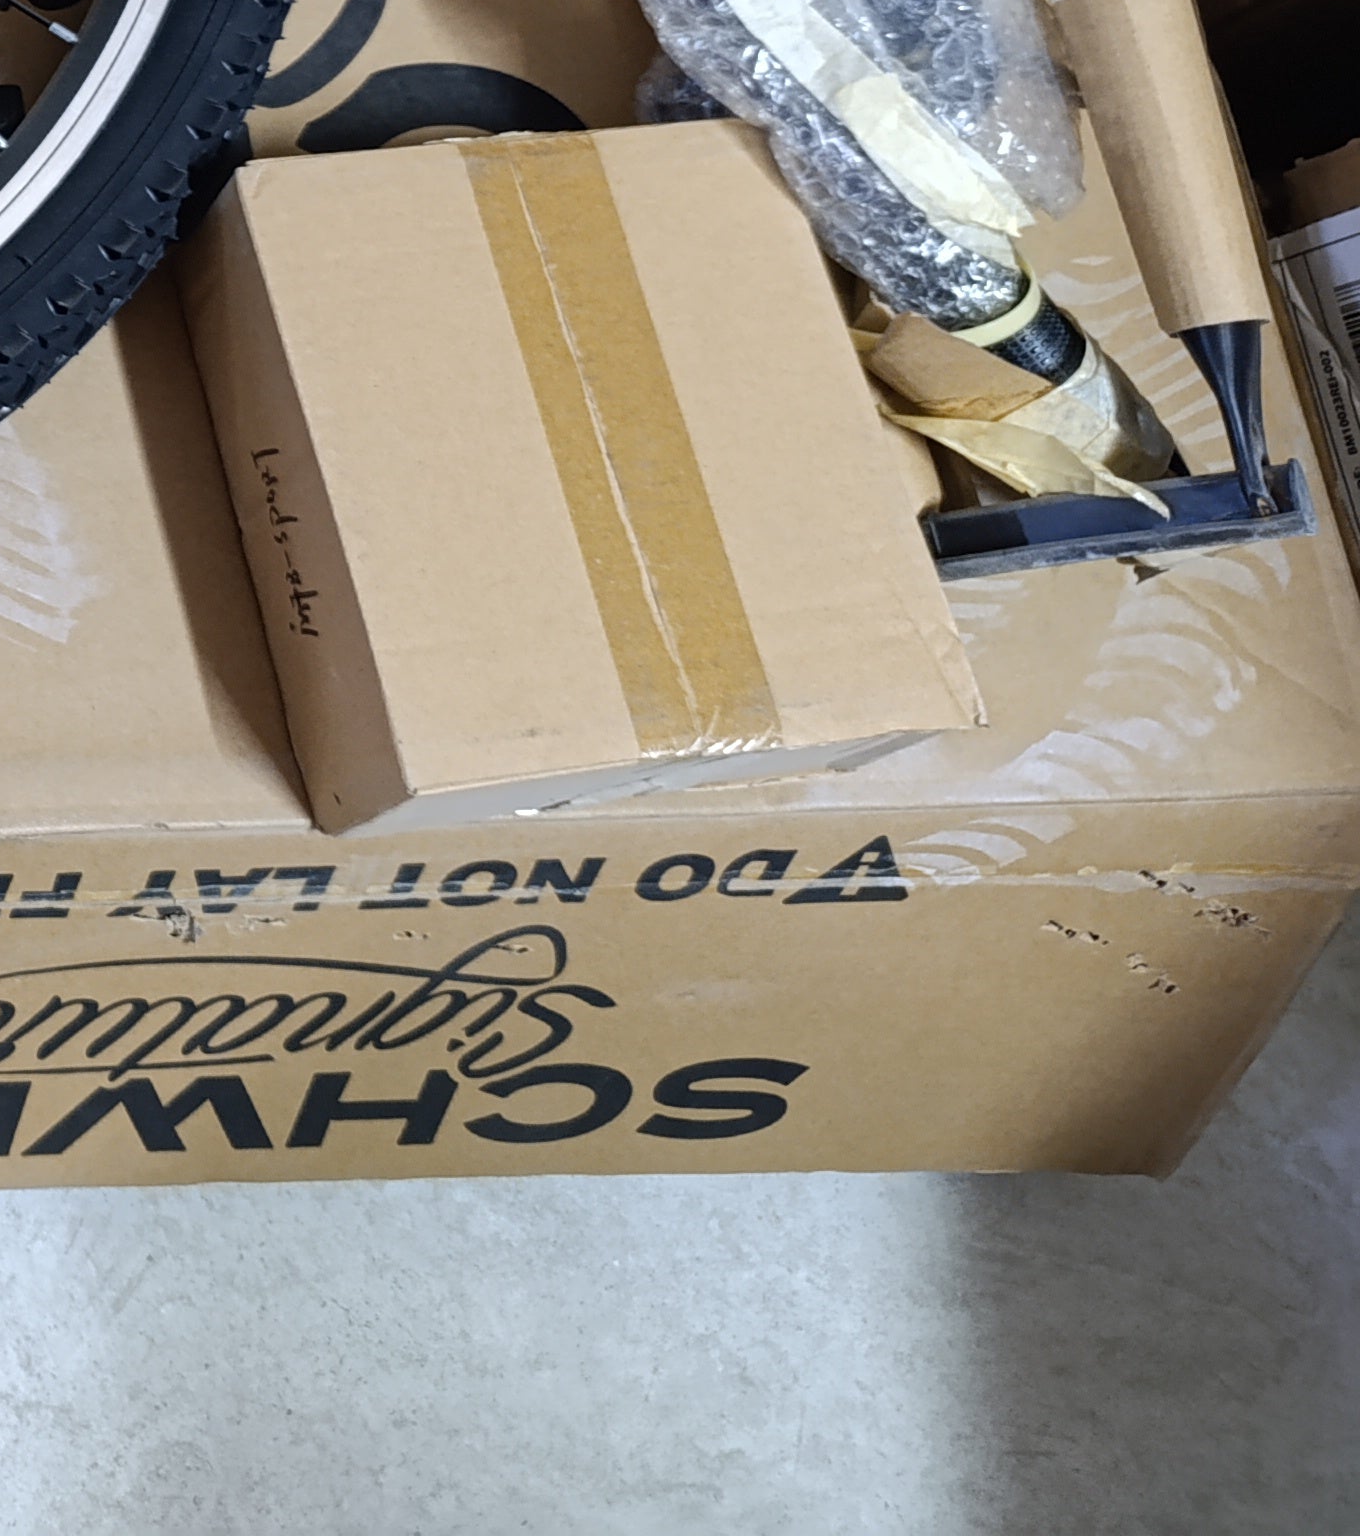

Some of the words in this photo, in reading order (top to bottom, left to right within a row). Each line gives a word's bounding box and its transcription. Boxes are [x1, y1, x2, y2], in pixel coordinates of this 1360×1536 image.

[106, 862, 338, 921] LAY
[359, 854, 608, 911] NOT
[629, 848, 794, 905] DO
